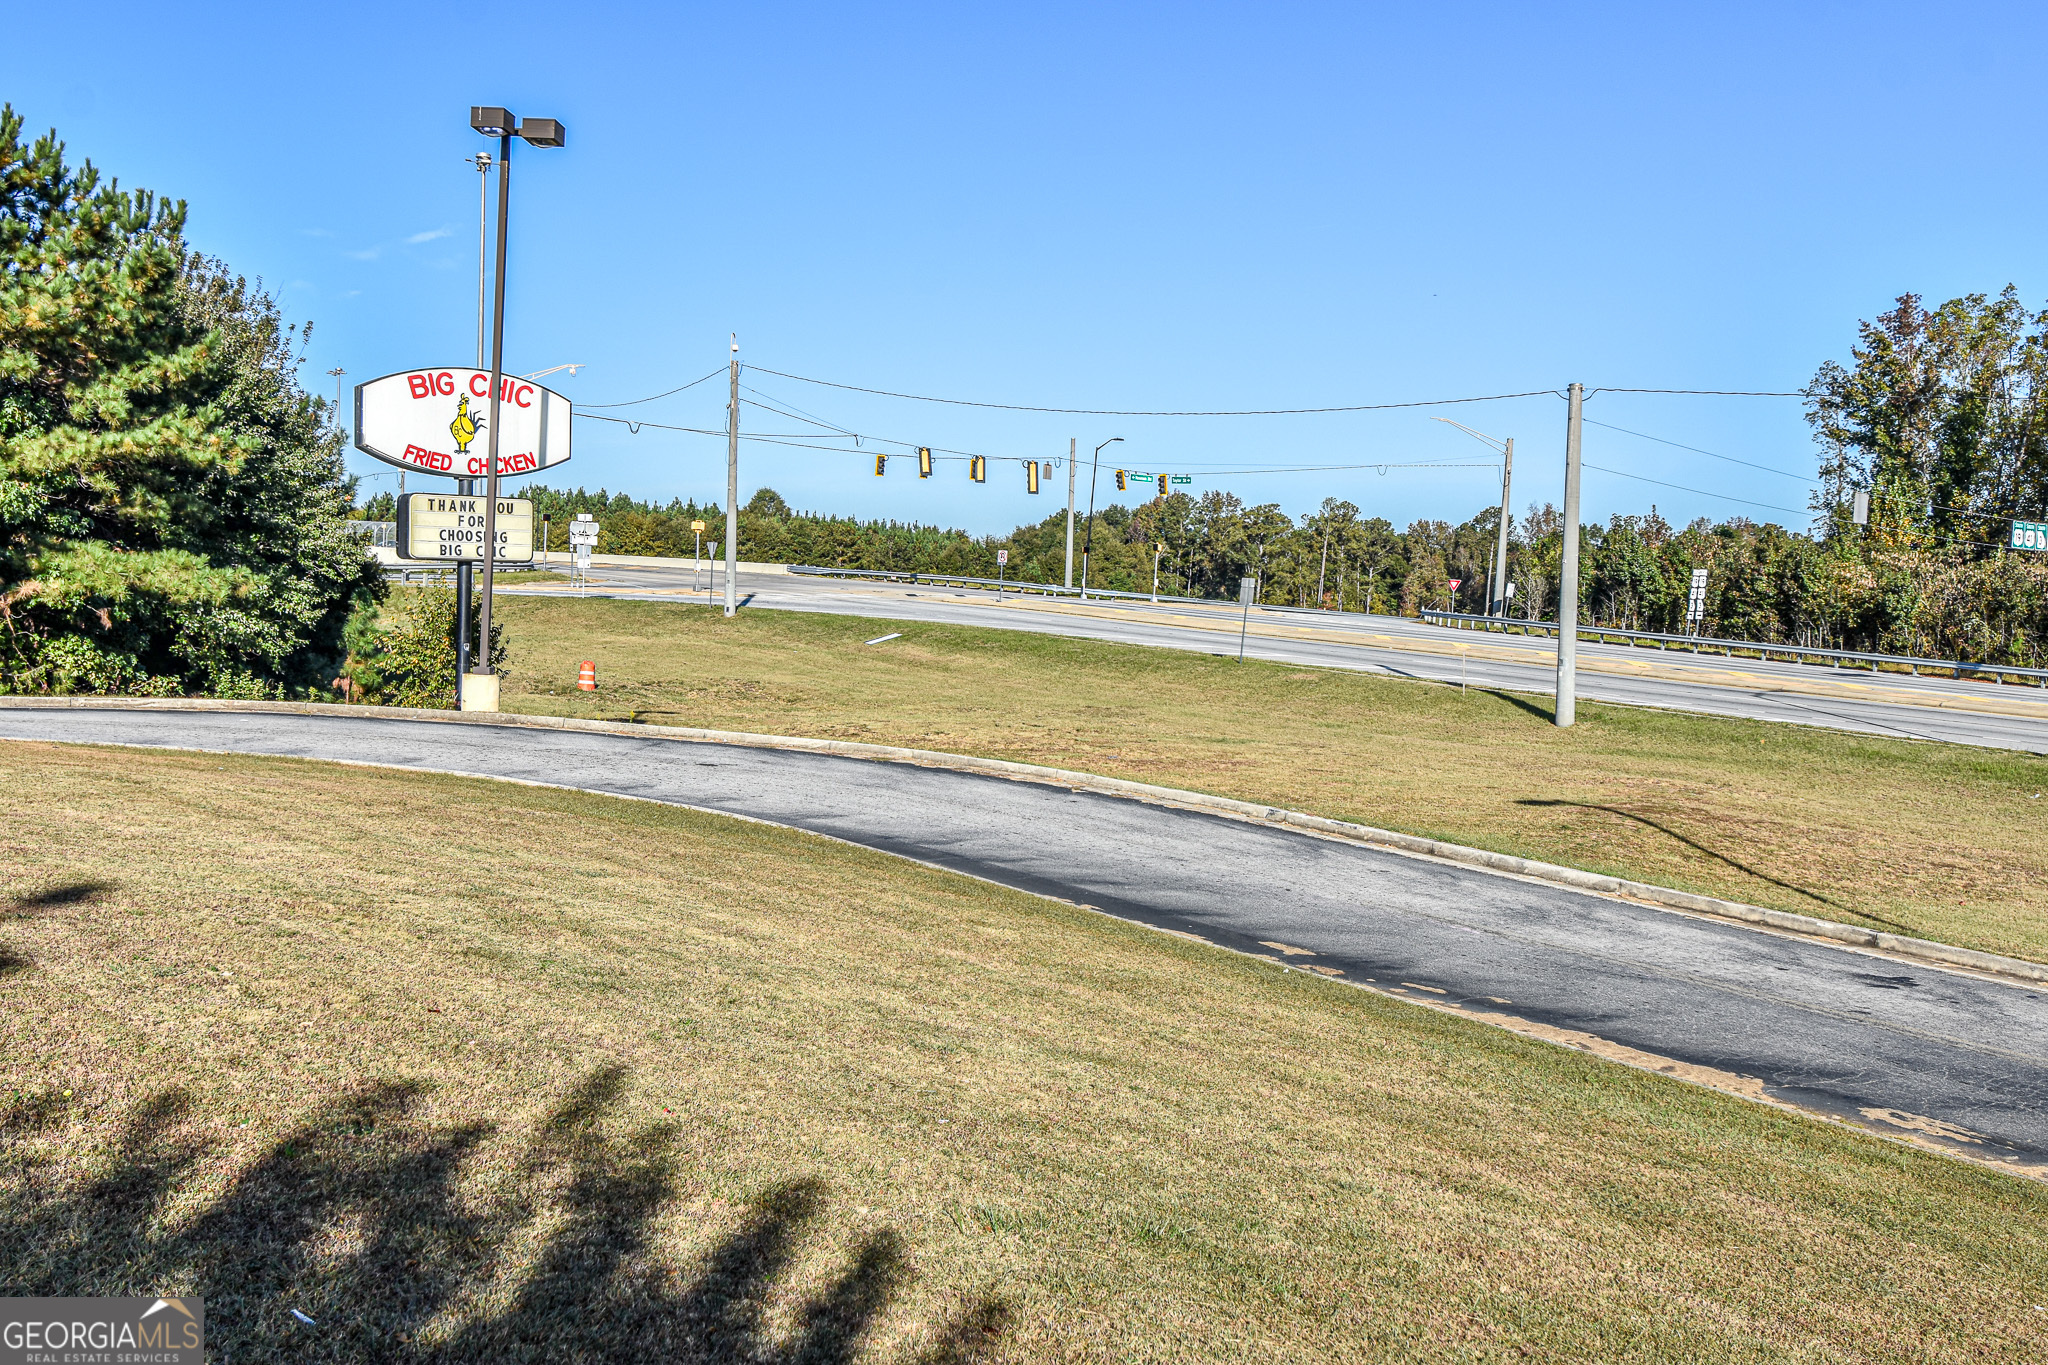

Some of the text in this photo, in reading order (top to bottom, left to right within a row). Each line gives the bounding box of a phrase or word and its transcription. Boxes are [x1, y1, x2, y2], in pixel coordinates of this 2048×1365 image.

[407, 371, 455, 400] BIG
[402, 443, 537, 475] FRIED CHCKEN
[428, 498, 514, 514] THANK OU
[458, 515, 485, 528] FOR
[440, 545, 506, 557] BIG CIC
